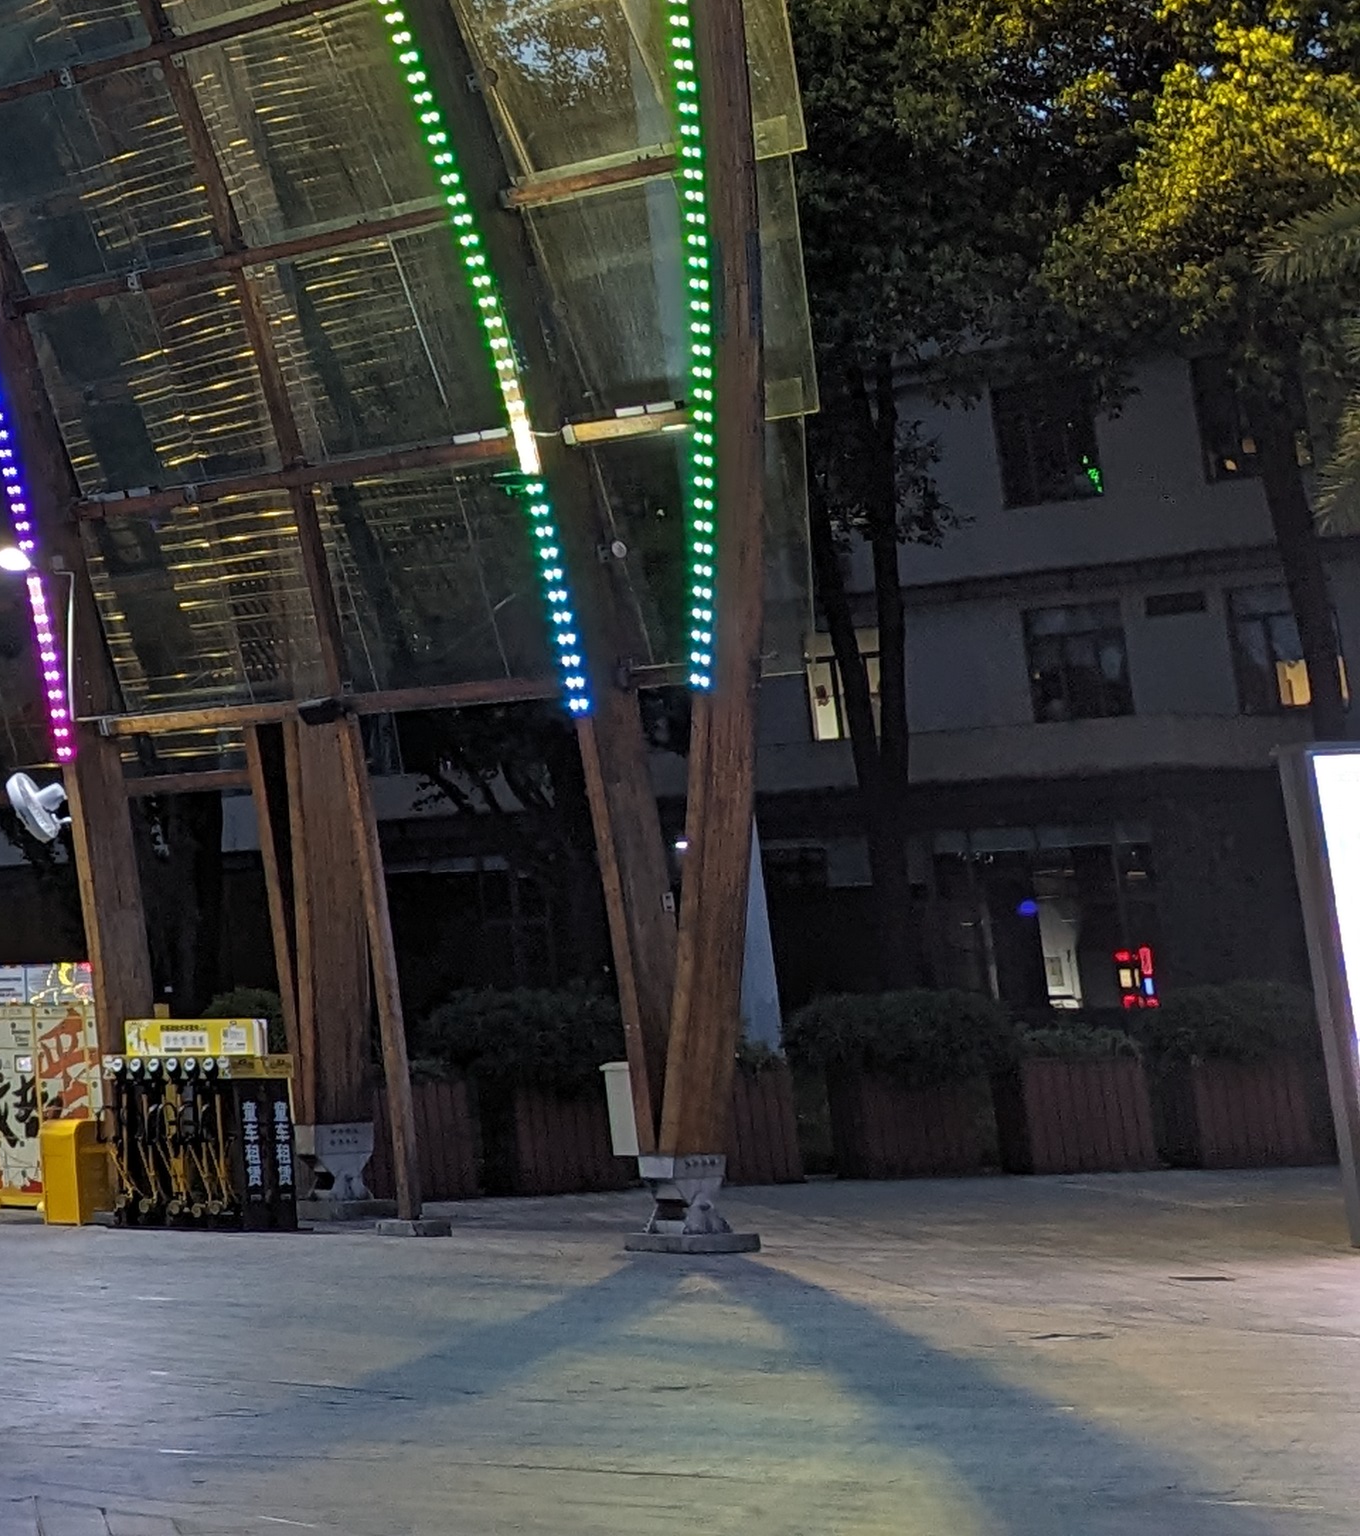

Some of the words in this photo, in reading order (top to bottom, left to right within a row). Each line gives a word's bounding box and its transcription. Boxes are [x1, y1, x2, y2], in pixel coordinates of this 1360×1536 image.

[241, 1100, 262, 1187] 童车租赁
[273, 1100, 293, 1187] 童车租赁
